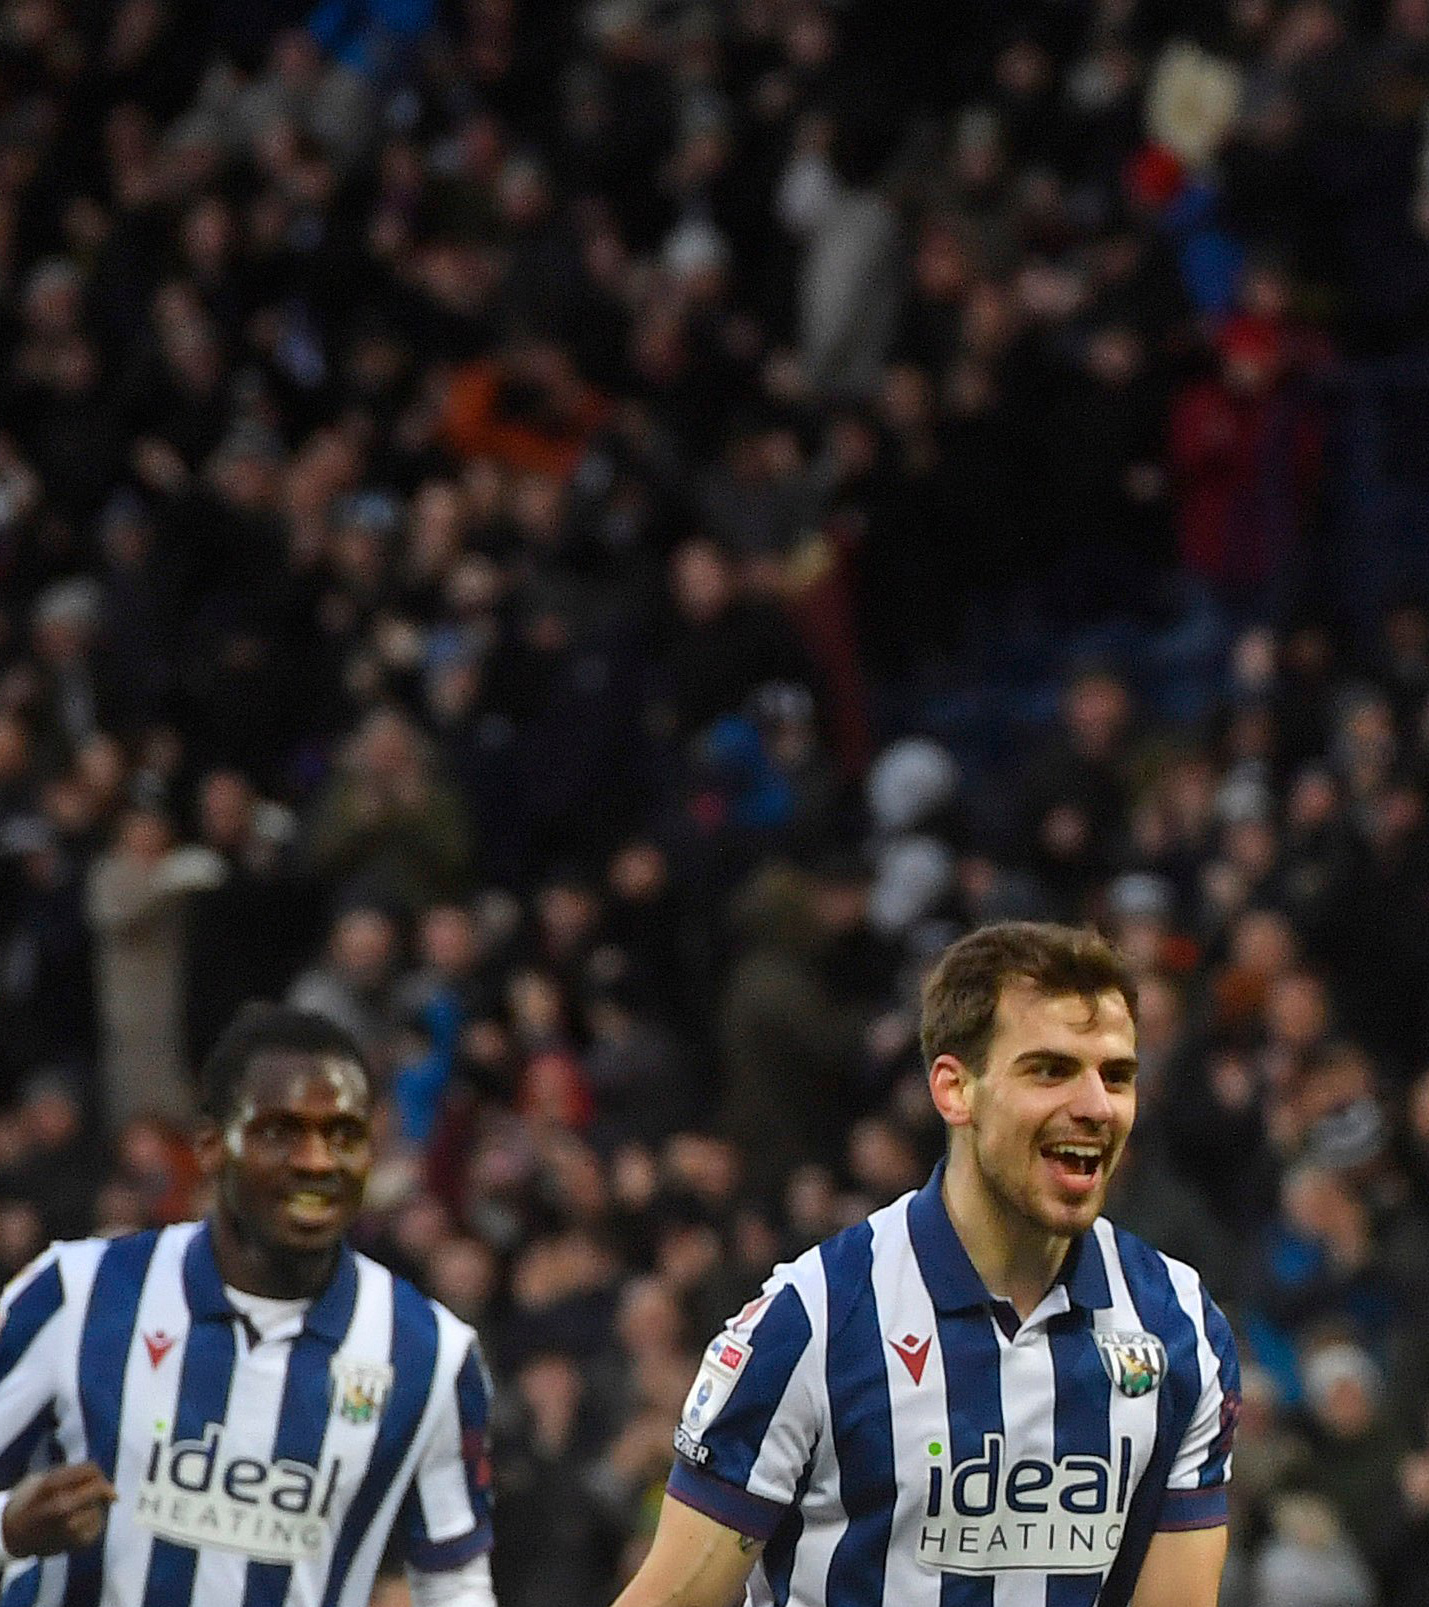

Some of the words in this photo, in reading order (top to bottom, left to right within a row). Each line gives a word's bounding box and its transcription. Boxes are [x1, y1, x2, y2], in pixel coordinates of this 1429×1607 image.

[147, 1418, 341, 1518] ideal
[926, 1437, 1131, 1518] ideal
[920, 1522, 1121, 1554] HEATING
